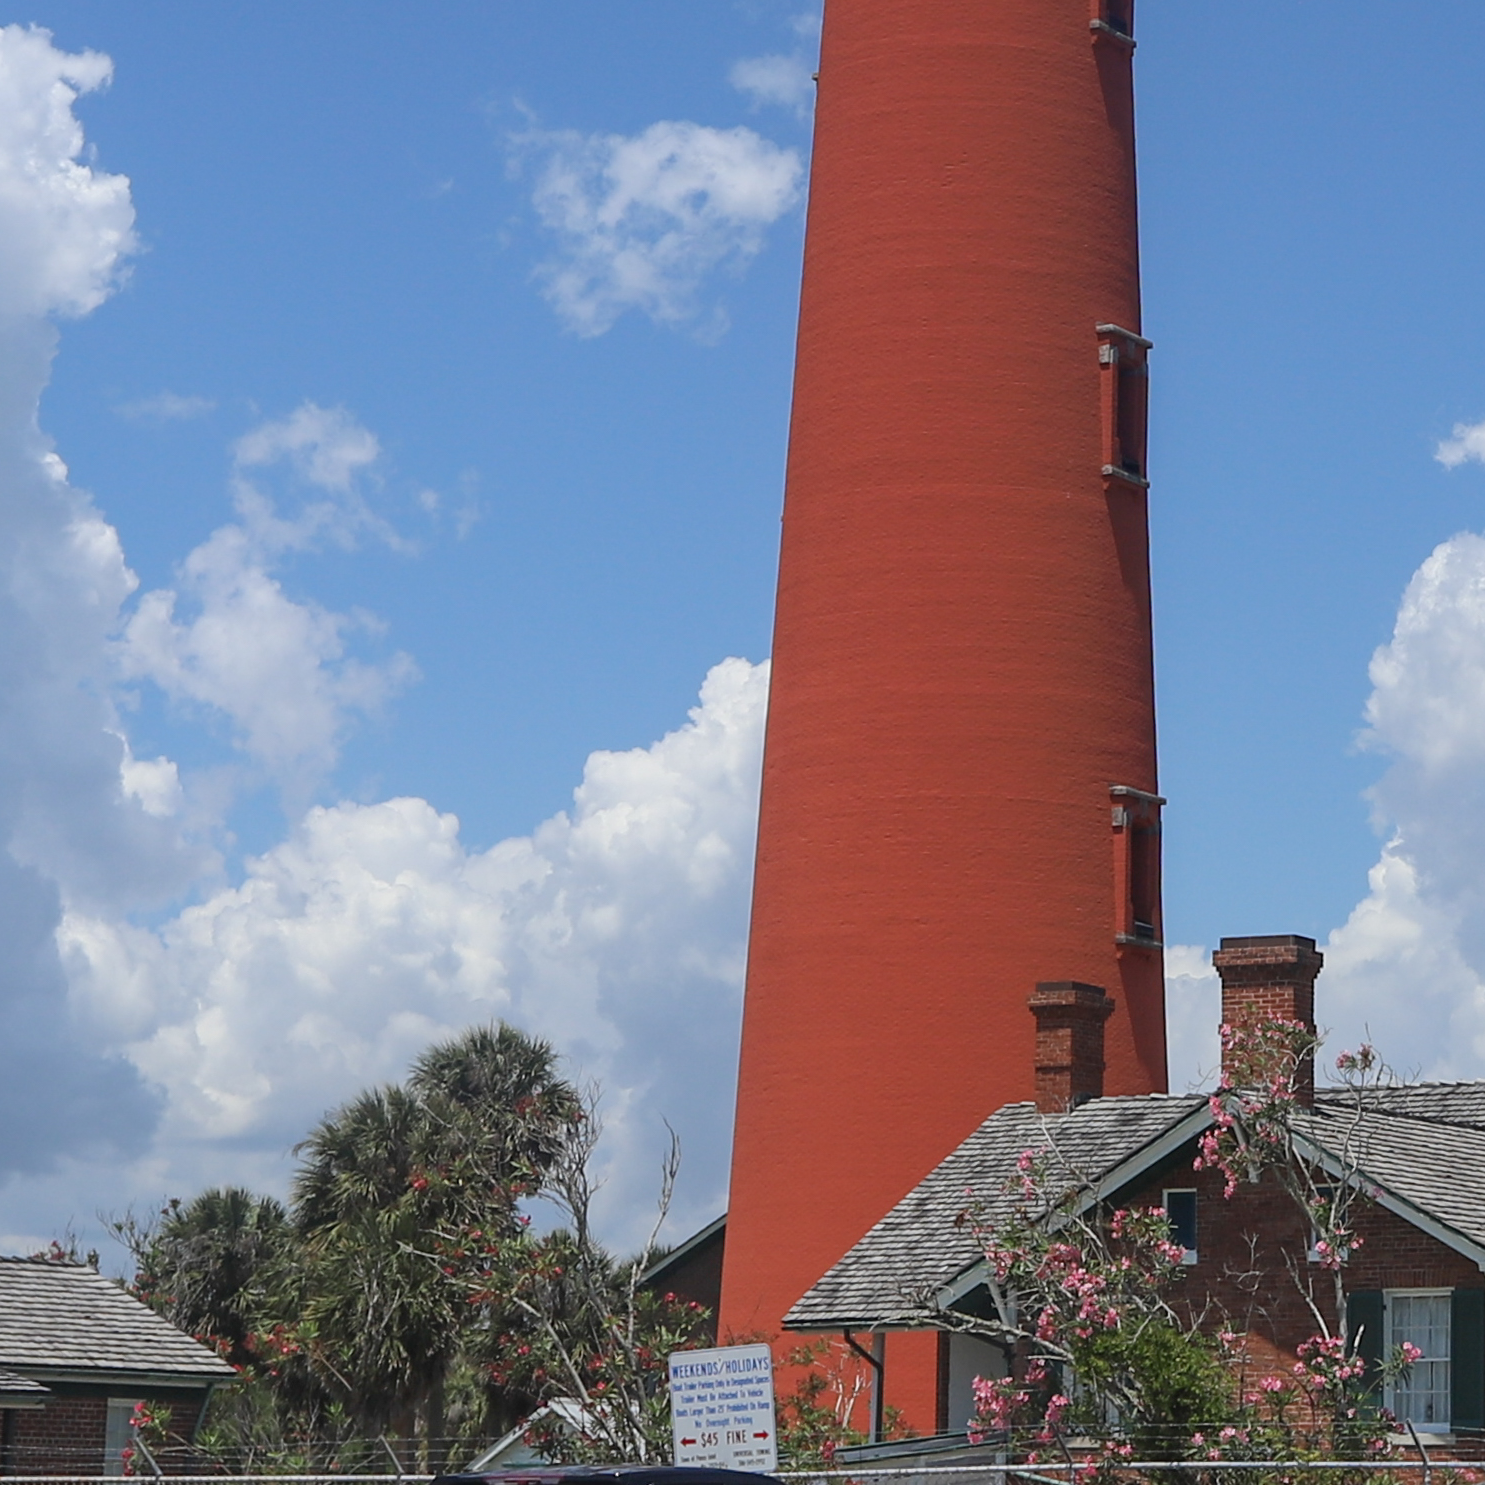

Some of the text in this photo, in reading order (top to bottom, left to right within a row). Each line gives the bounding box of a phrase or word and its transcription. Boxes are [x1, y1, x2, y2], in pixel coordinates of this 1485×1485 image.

[698, 1381, 714, 1390] Parking
[731, 1378, 753, 1387] Designated
[718, 1391, 738, 1400] Attached
[748, 1389, 763, 1397] Vehicle
[690, 1408, 703, 1417] Larger
[706, 1406, 716, 1414] Than
[726, 1403, 748, 1412] Prohibited
[758, 1401, 769, 1410] Ramp
[695, 1417, 753, 1428] No Overnight Parking
[701, 1430, 746, 1447] $45 FINE
